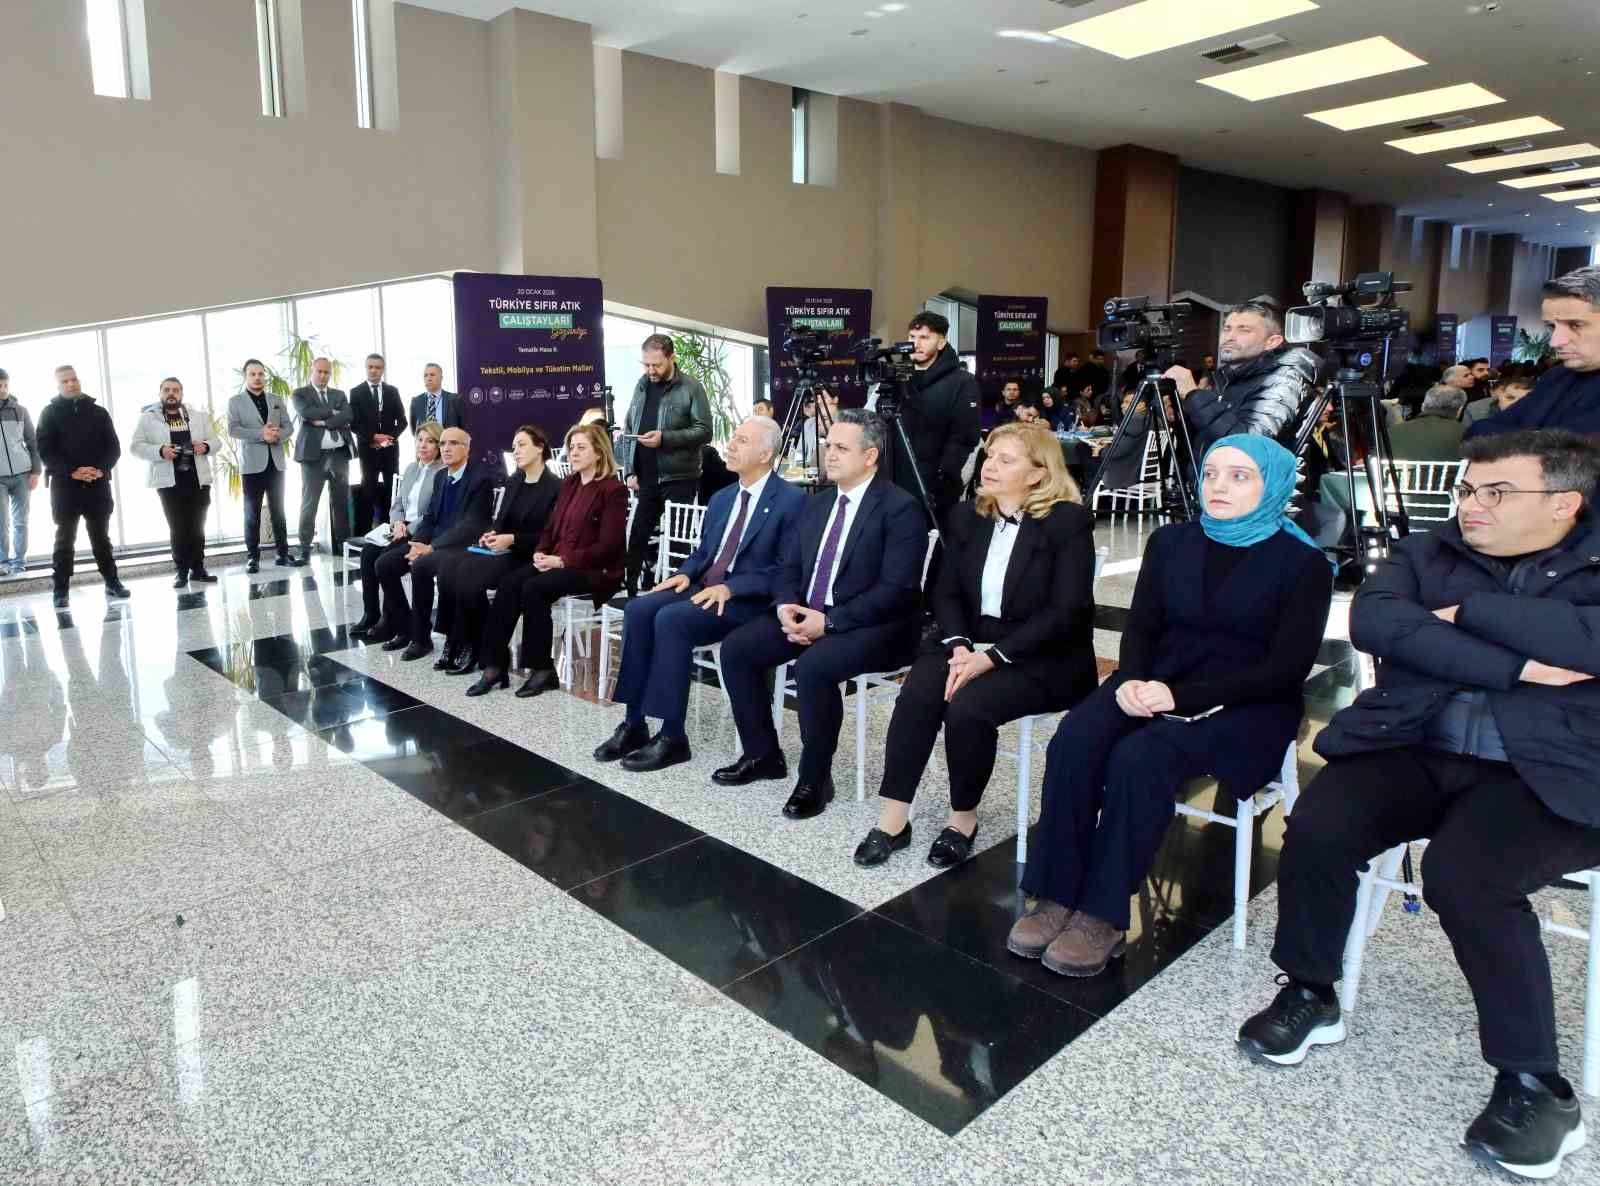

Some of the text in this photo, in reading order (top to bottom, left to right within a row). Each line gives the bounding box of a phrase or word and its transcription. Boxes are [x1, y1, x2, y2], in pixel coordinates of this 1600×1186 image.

[489, 298, 581, 311] TÜRKİYE SIFIR ATIK
[785, 305, 851, 316] TÜRKİYE SIFIR ATIK
[502, 315, 570, 326] ÇALIŞTAYLARI
[507, 366, 534, 376] Mobilya
